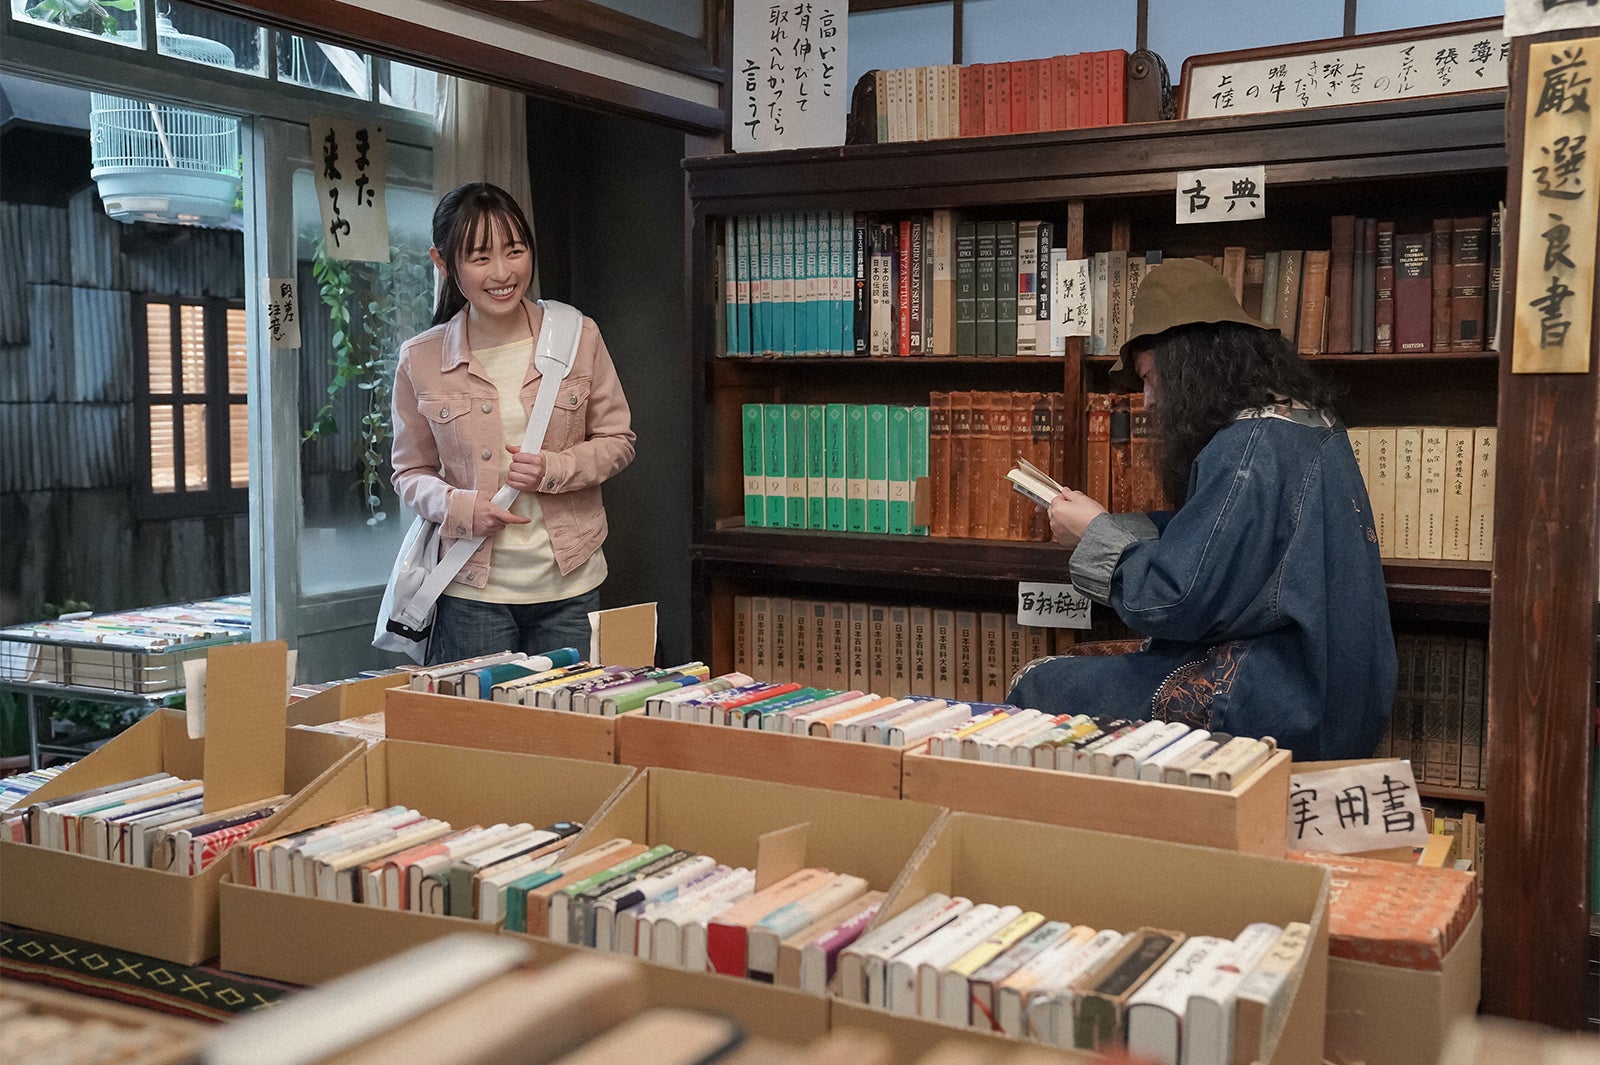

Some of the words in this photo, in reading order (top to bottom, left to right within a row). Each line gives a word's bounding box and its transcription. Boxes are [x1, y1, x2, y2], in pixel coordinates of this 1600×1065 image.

[767, 5, 789, 135] 取れへんかったら
[793, 3, 814, 112] 背伸びして
[819, 9, 837, 97] 高いとこ
[1396, 45, 1418, 94] マンホール
[1468, 38, 1496, 78] 薄く
[1211, 75, 1234, 109] 上陸
[1245, 85, 1260, 98] の
[1322, 58, 1345, 97] 泳ぎ
[1373, 75, 1391, 91] の
[742, 59, 761, 140] 言うて
[355, 128, 375, 207] また
[322, 128, 351, 248] 来てや
[1181, 177, 1261, 214] 古典
[1529, 46, 1593, 350] 厳選良書
[1040, 227, 1048, 279] 古典落語全集
[900, 250, 908, 309] BYZANTIUM
[963, 284, 970, 292] 12
[982, 283, 989, 291] 13
[1003, 283, 1009, 291] 11
[268, 301, 285, 341] 注意
[280, 283, 294, 322] 段差
[912, 290, 920, 321] SEURAT
[1040, 293, 1048, 319] 第1巻
[1062, 278, 1075, 325] 禁止
[911, 335, 920, 346] 20
[1379, 438, 1388, 479] 今昔物語集
[749, 481, 759, 491] 10
[771, 481, 779, 491] 9
[793, 483, 800, 492] 8
[831, 482, 839, 492] 6
[853, 483, 860, 493] 5
[895, 486, 903, 496] 2
[1020, 591, 1089, 619] 百科辞典
[834, 620, 842, 674] 日本百科大事典
[854, 622, 862, 676] 日本百科大事典
[874, 623, 882, 676] 日本百科大事典
[895, 624, 903, 678] 日本百科大事典
[916, 625, 924, 680] 日本百科大事典
[939, 627, 947, 681] 日本百科大事典
[962, 629, 970, 685] 日本百科大事典
[1290, 774, 1416, 840] 実用書
